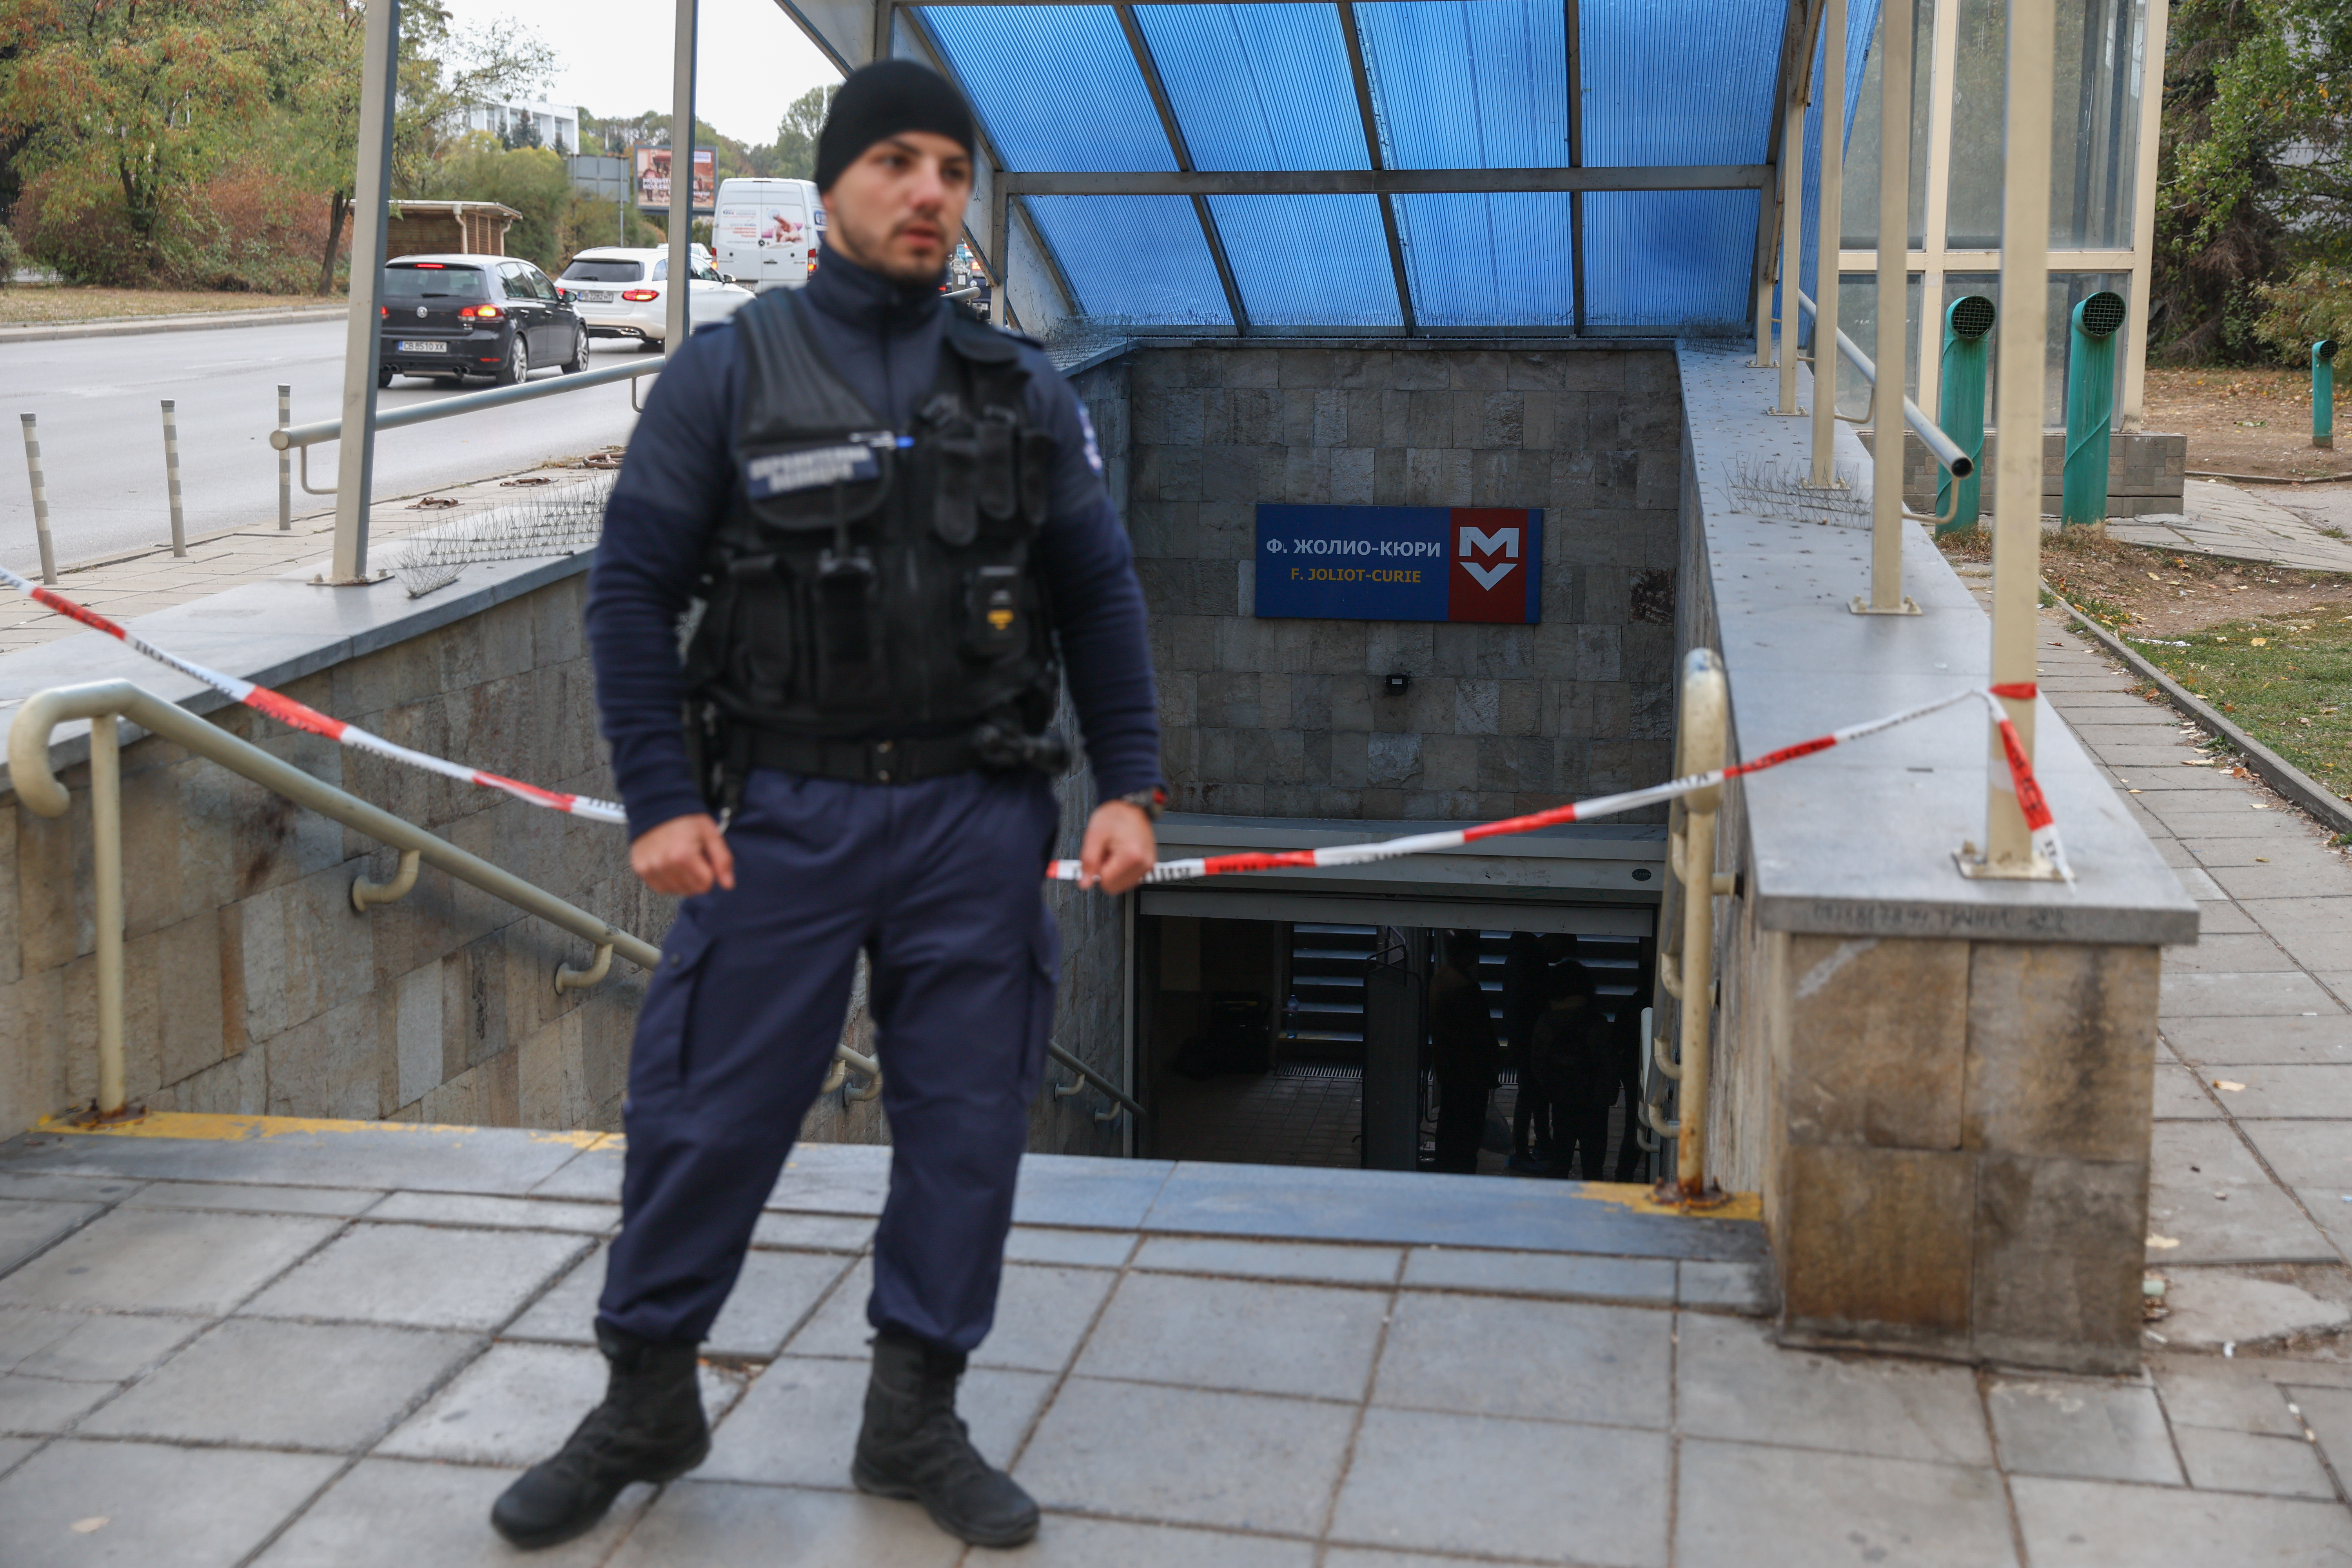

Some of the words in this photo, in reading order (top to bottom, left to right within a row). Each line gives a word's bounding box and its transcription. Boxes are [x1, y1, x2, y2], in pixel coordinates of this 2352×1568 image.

[1266, 539, 1287, 554] Ф.
[1294, 539, 1441, 557] ЖОЛИО-КЮРИ
[1291, 568, 1303, 580] F.
[1308, 569, 1421, 583] JOLIOT-CURIE
